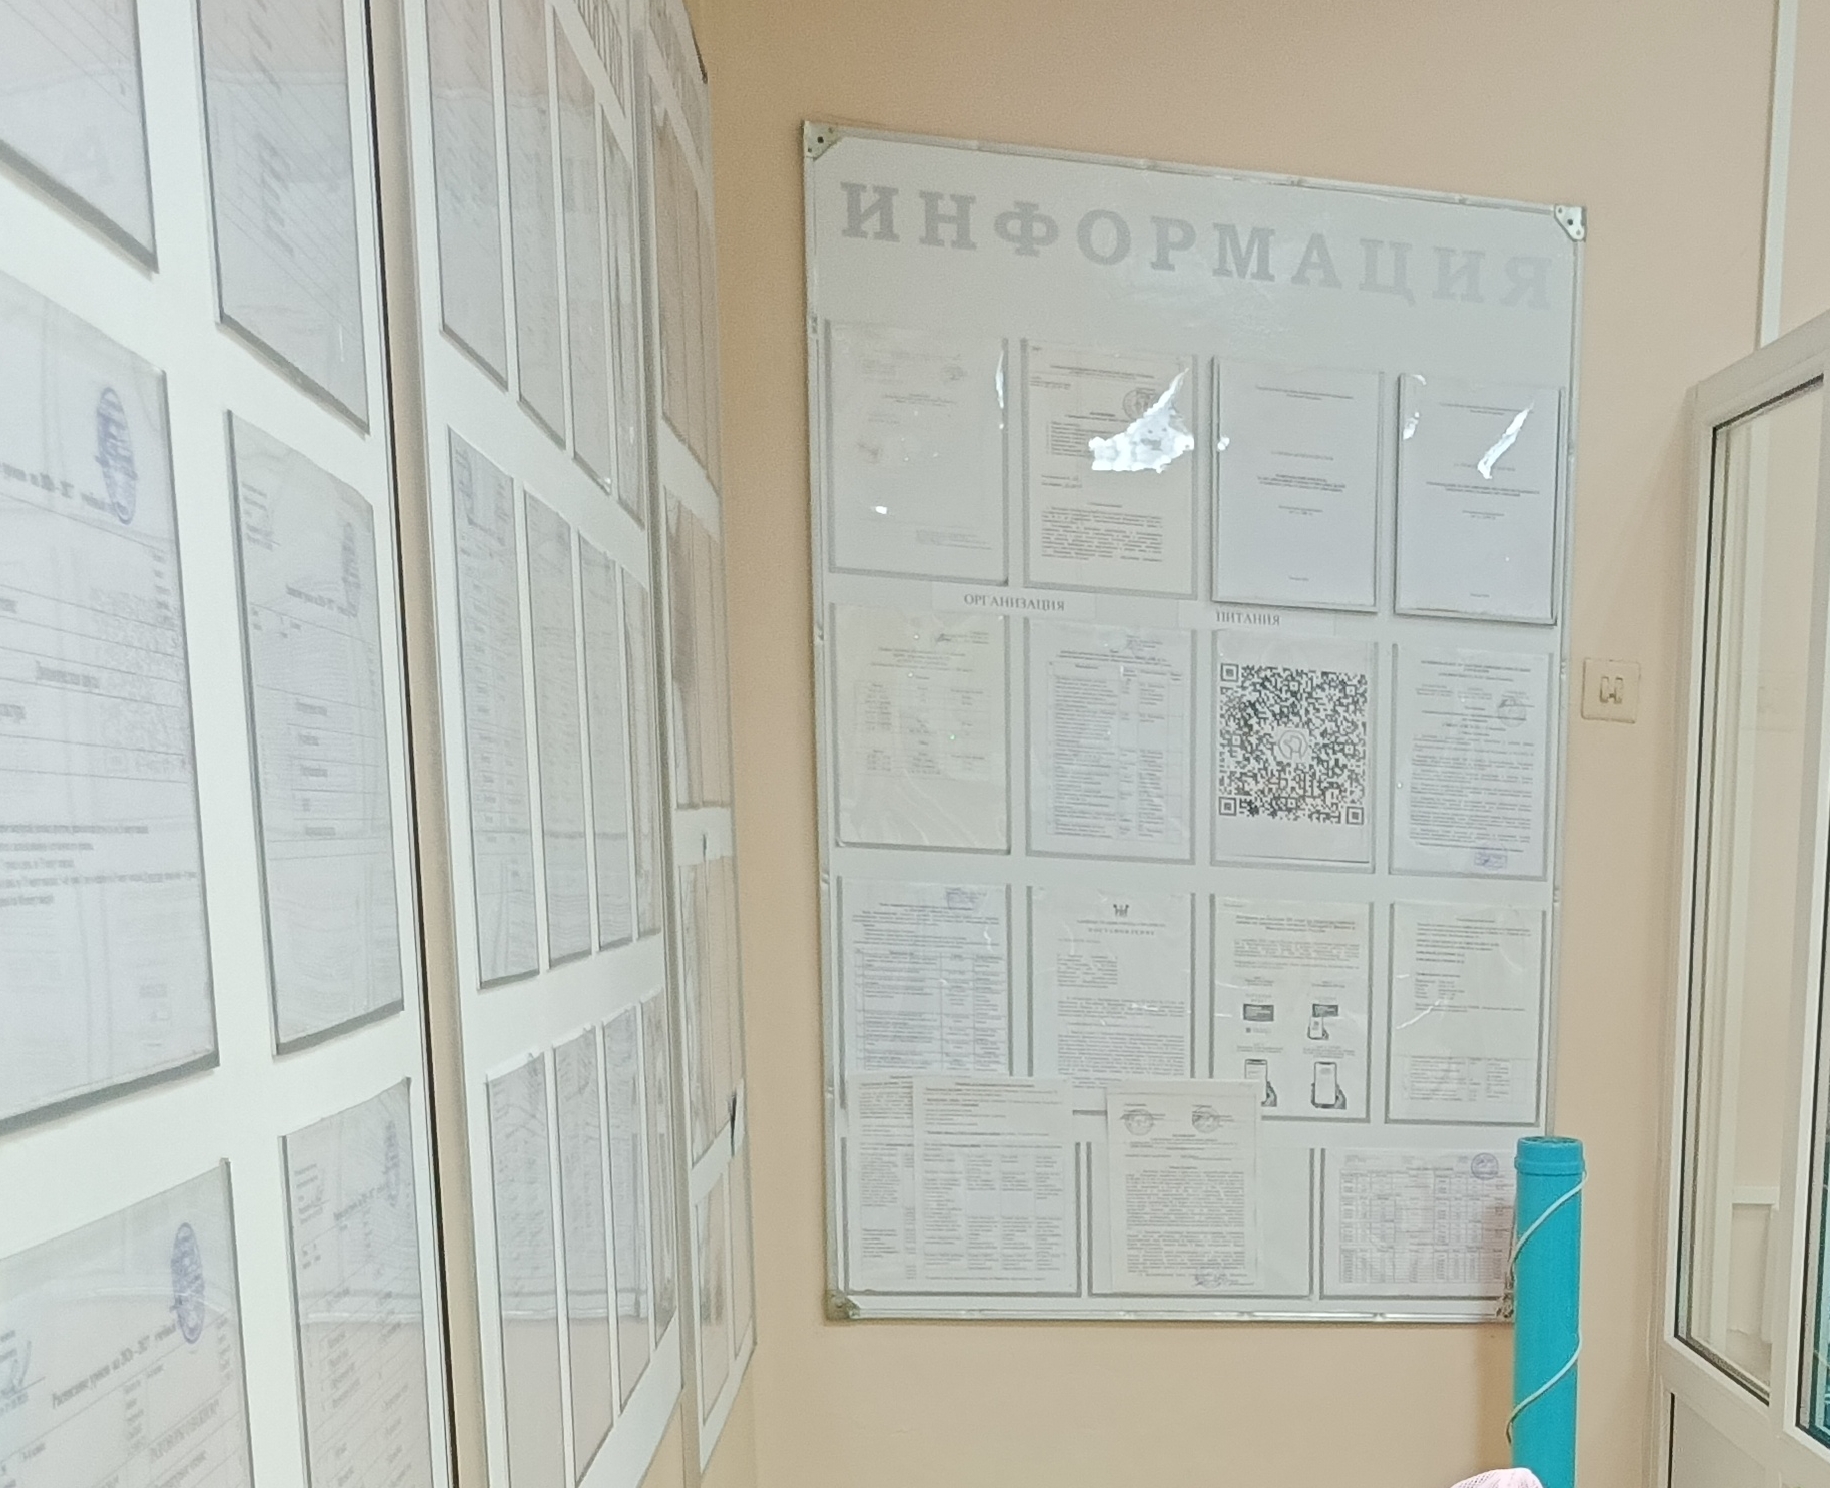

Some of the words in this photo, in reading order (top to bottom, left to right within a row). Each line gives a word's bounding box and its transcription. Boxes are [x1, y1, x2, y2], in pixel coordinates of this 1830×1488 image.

[840, 181, 1553, 312] ИНФОРМАЦИЯ
[964, 594, 1065, 612] ОРГАНИЗАЦИЯ
[1215, 610, 1281, 627] ПИТАНИЯ
